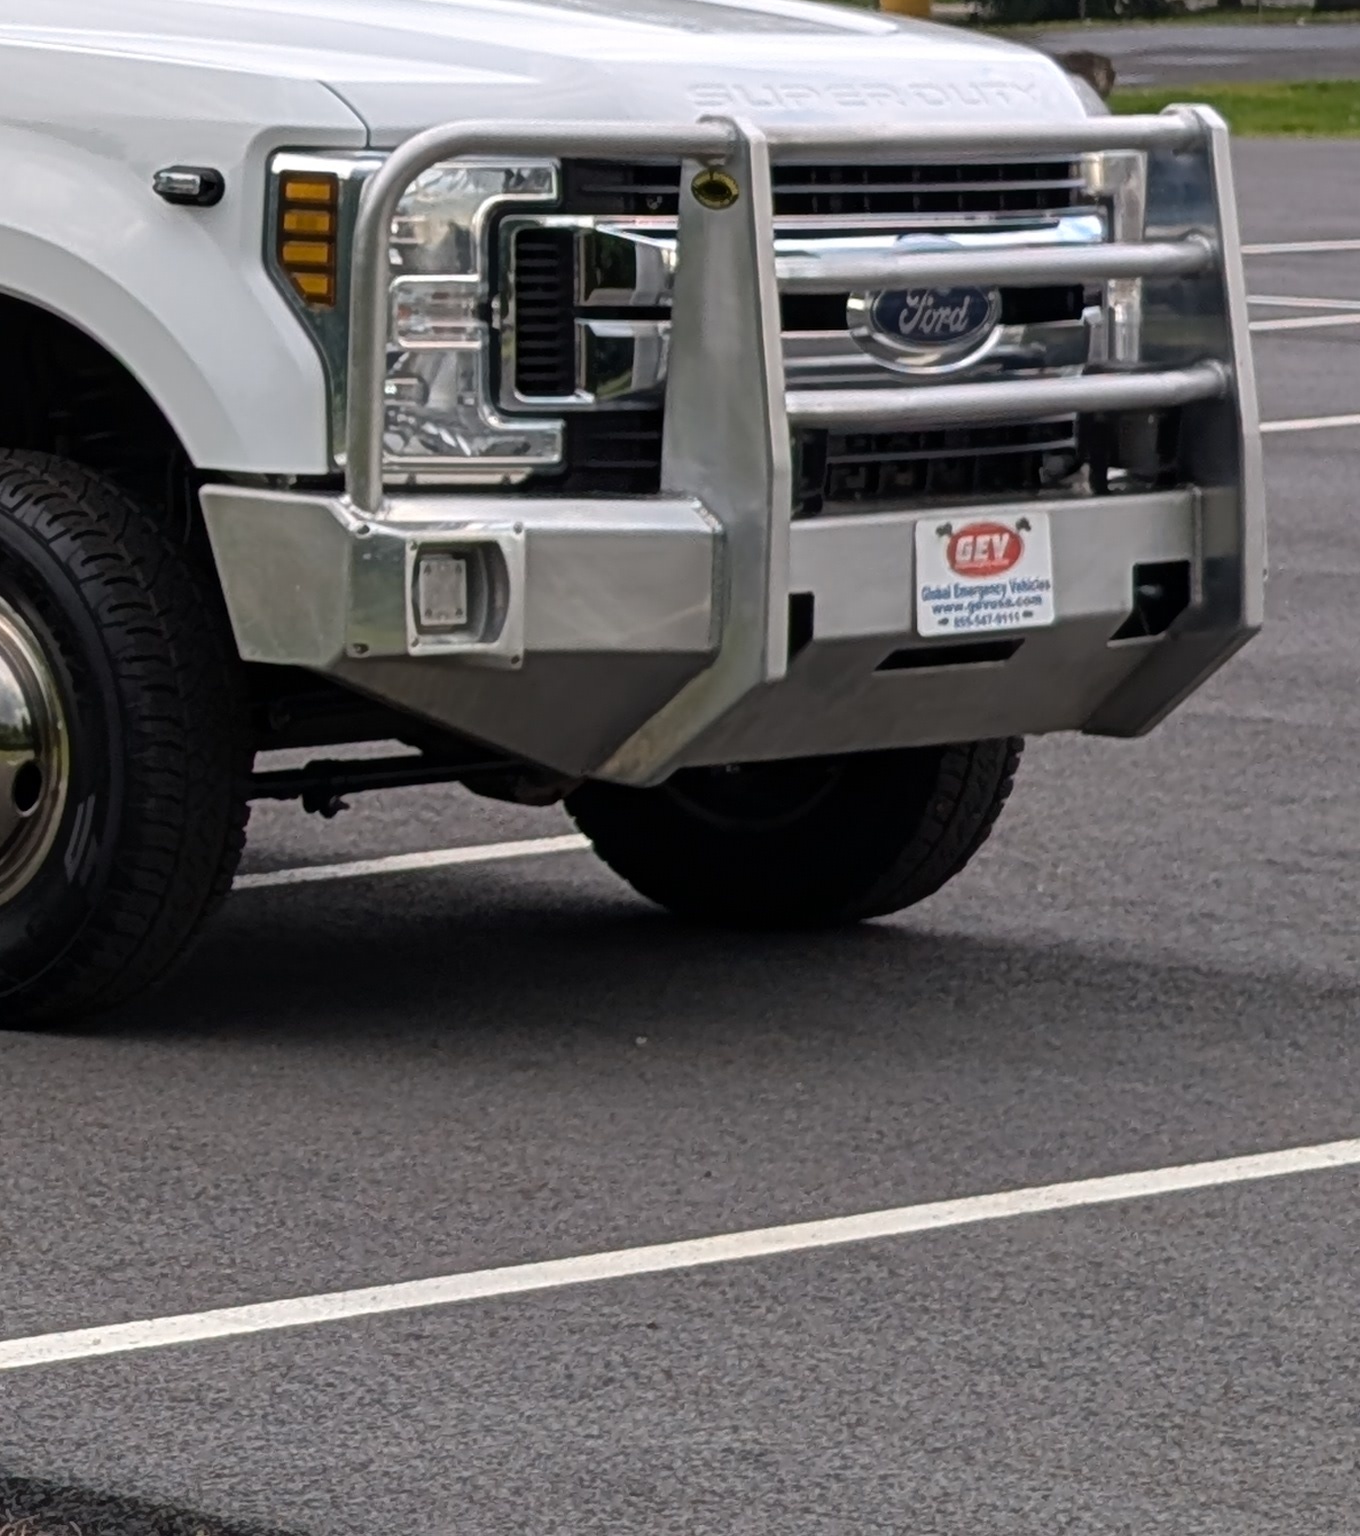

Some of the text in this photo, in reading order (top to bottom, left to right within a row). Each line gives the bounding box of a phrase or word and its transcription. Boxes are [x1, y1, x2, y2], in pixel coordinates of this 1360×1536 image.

[688, 81, 1038, 108] SUPER DUTY
[898, 288, 972, 335] Ford
[955, 533, 1010, 563] GEV
[921, 577, 1051, 602] Global Emergency Vehicles
